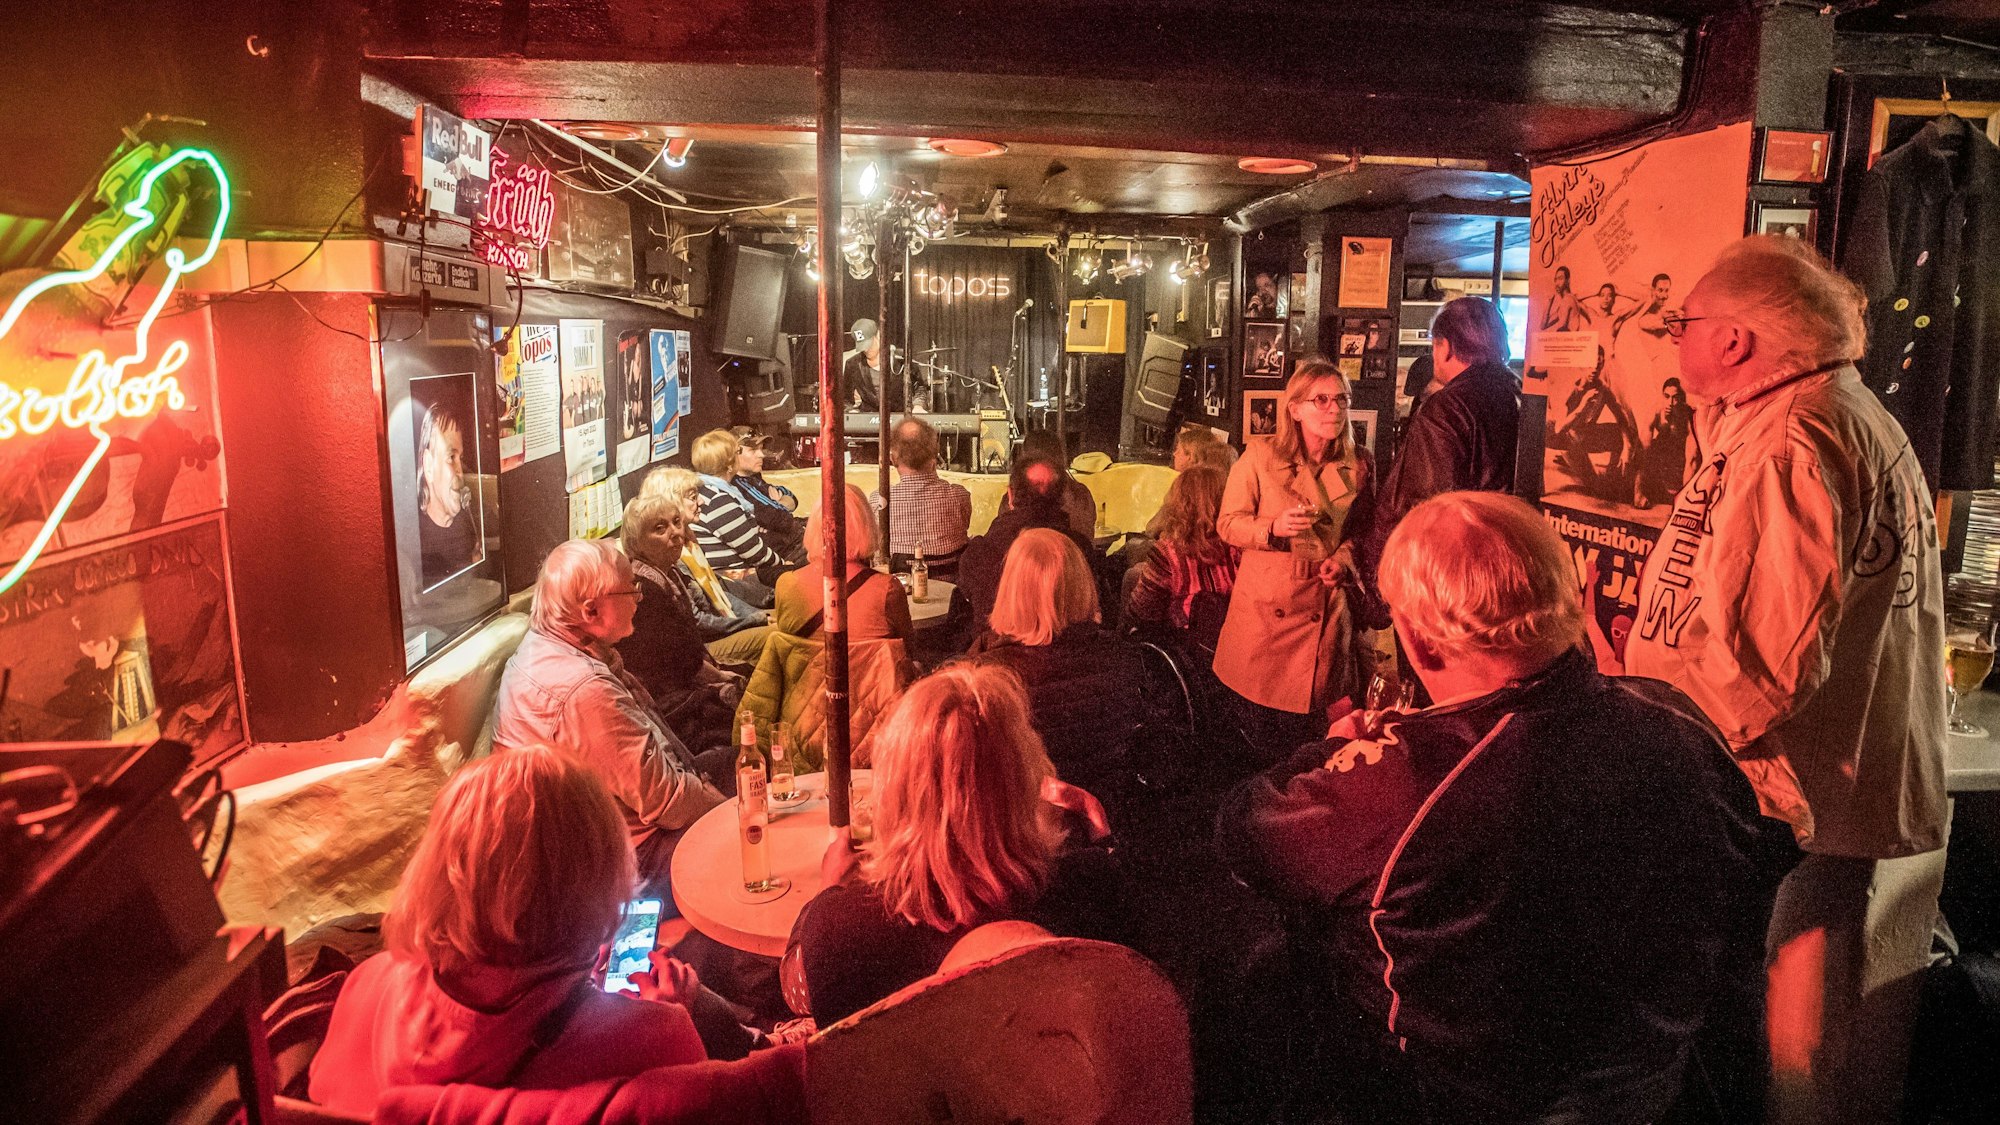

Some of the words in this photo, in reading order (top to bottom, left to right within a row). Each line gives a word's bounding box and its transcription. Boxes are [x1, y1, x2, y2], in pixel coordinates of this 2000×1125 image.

[432, 116, 459, 154] Red
[460, 130, 482, 162] Bull
[479, 145, 555, 249] Früh
[1532, 162, 1588, 243] Alvin
[1541, 175, 1605, 268] Ailey's
[411, 265, 442, 285] Kozerte
[913, 268, 1010, 304] topos
